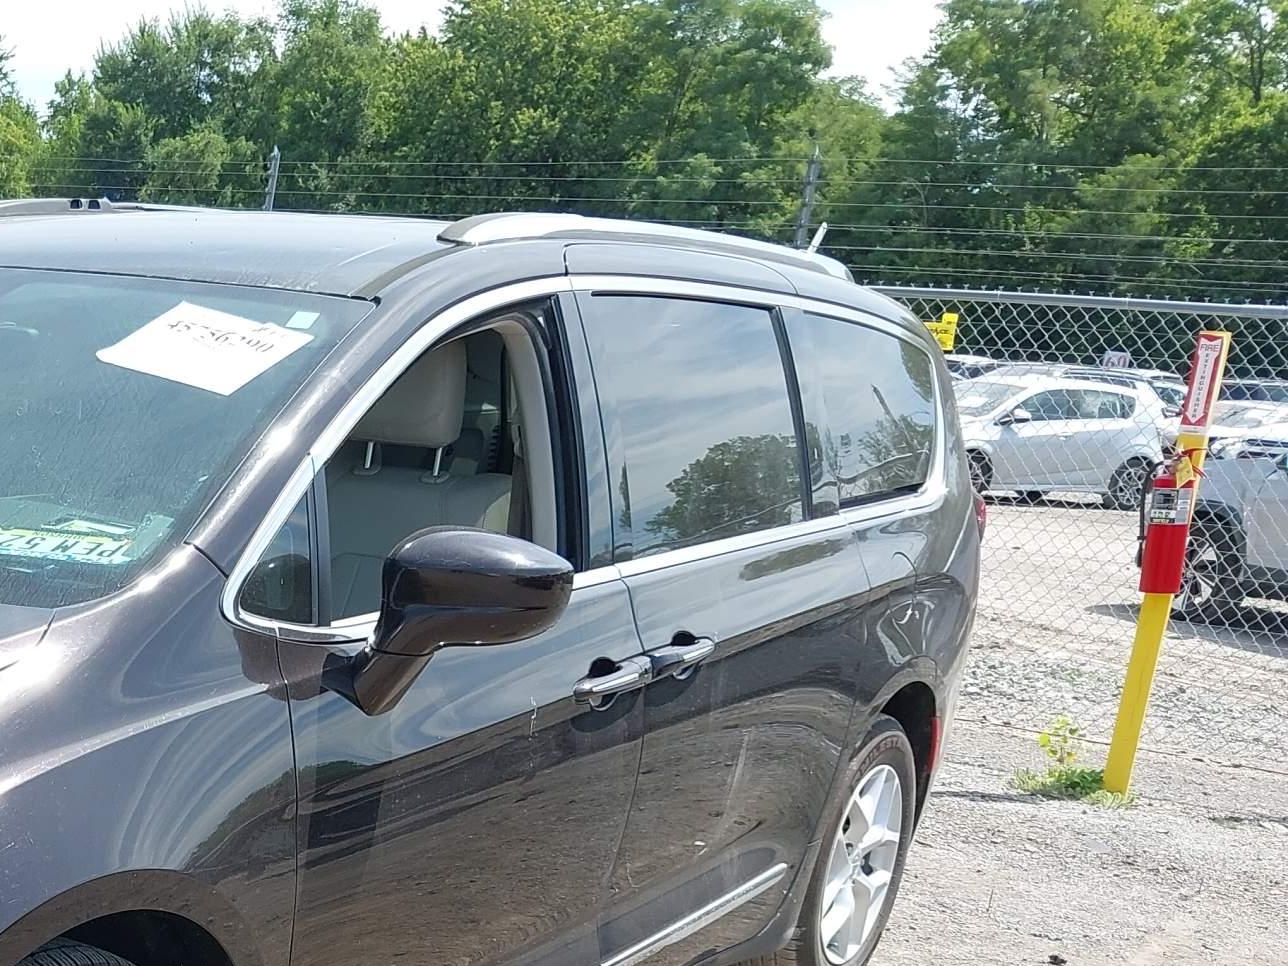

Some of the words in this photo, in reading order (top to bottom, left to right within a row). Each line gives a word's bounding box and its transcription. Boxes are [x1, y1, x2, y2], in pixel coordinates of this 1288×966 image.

[1200, 343, 1220, 352] FIRE
[1192, 353, 1209, 417] EXTINGUISHER
[51, 540, 123, 557] PEM
